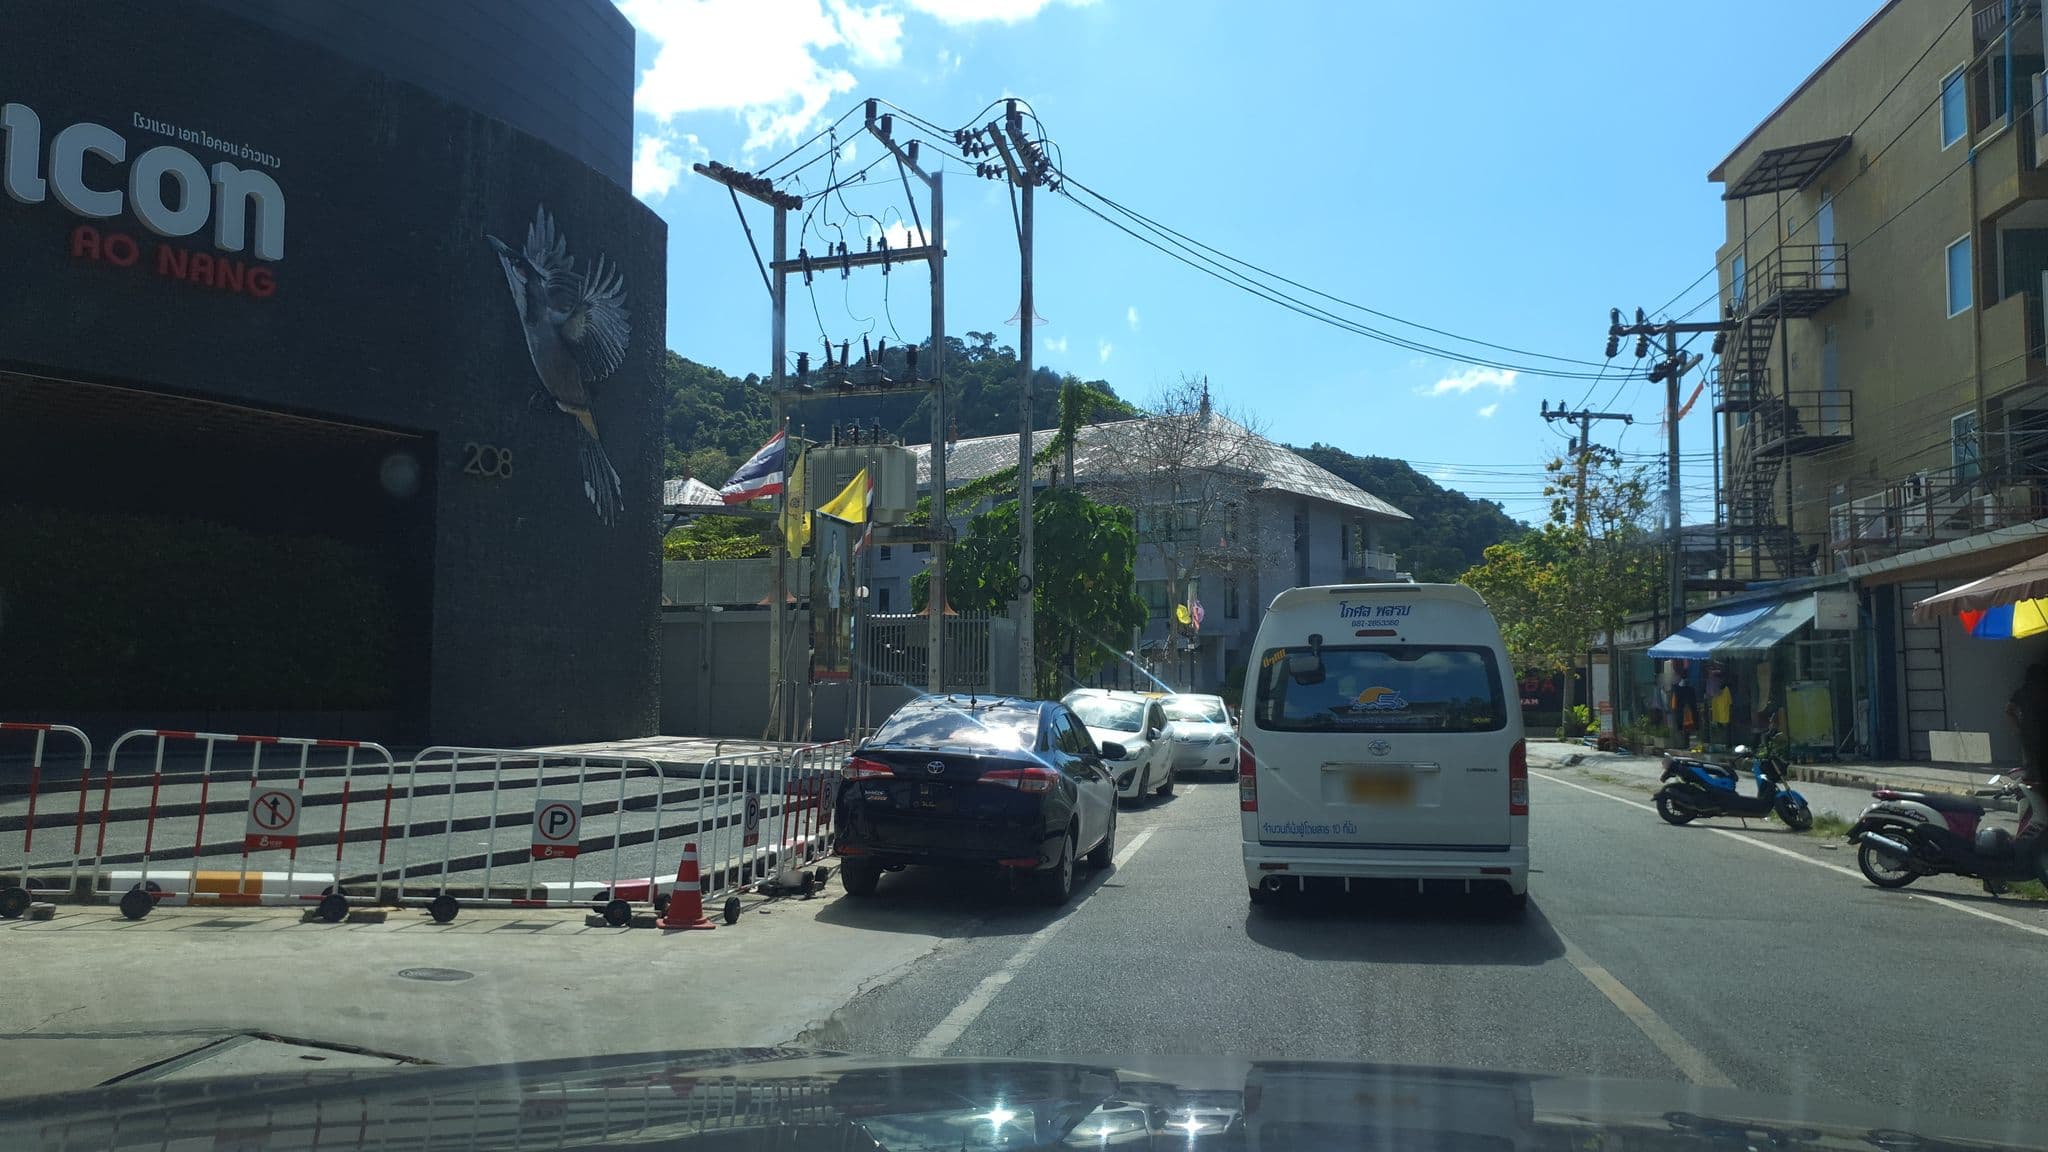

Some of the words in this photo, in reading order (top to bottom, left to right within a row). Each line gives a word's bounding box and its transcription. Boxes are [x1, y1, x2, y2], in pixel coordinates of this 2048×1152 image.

[133, 111, 175, 137] โรงแรม
[201, 131, 238, 156] ไอคอน
[241, 143, 281, 169] อ่าวนาง
[71, 224, 140, 267] AO
[156, 243, 278, 298] NANG
[464, 441, 513, 479] 208
[549, 811, 569, 834] P
[1332, 824, 1341, 834] 10
